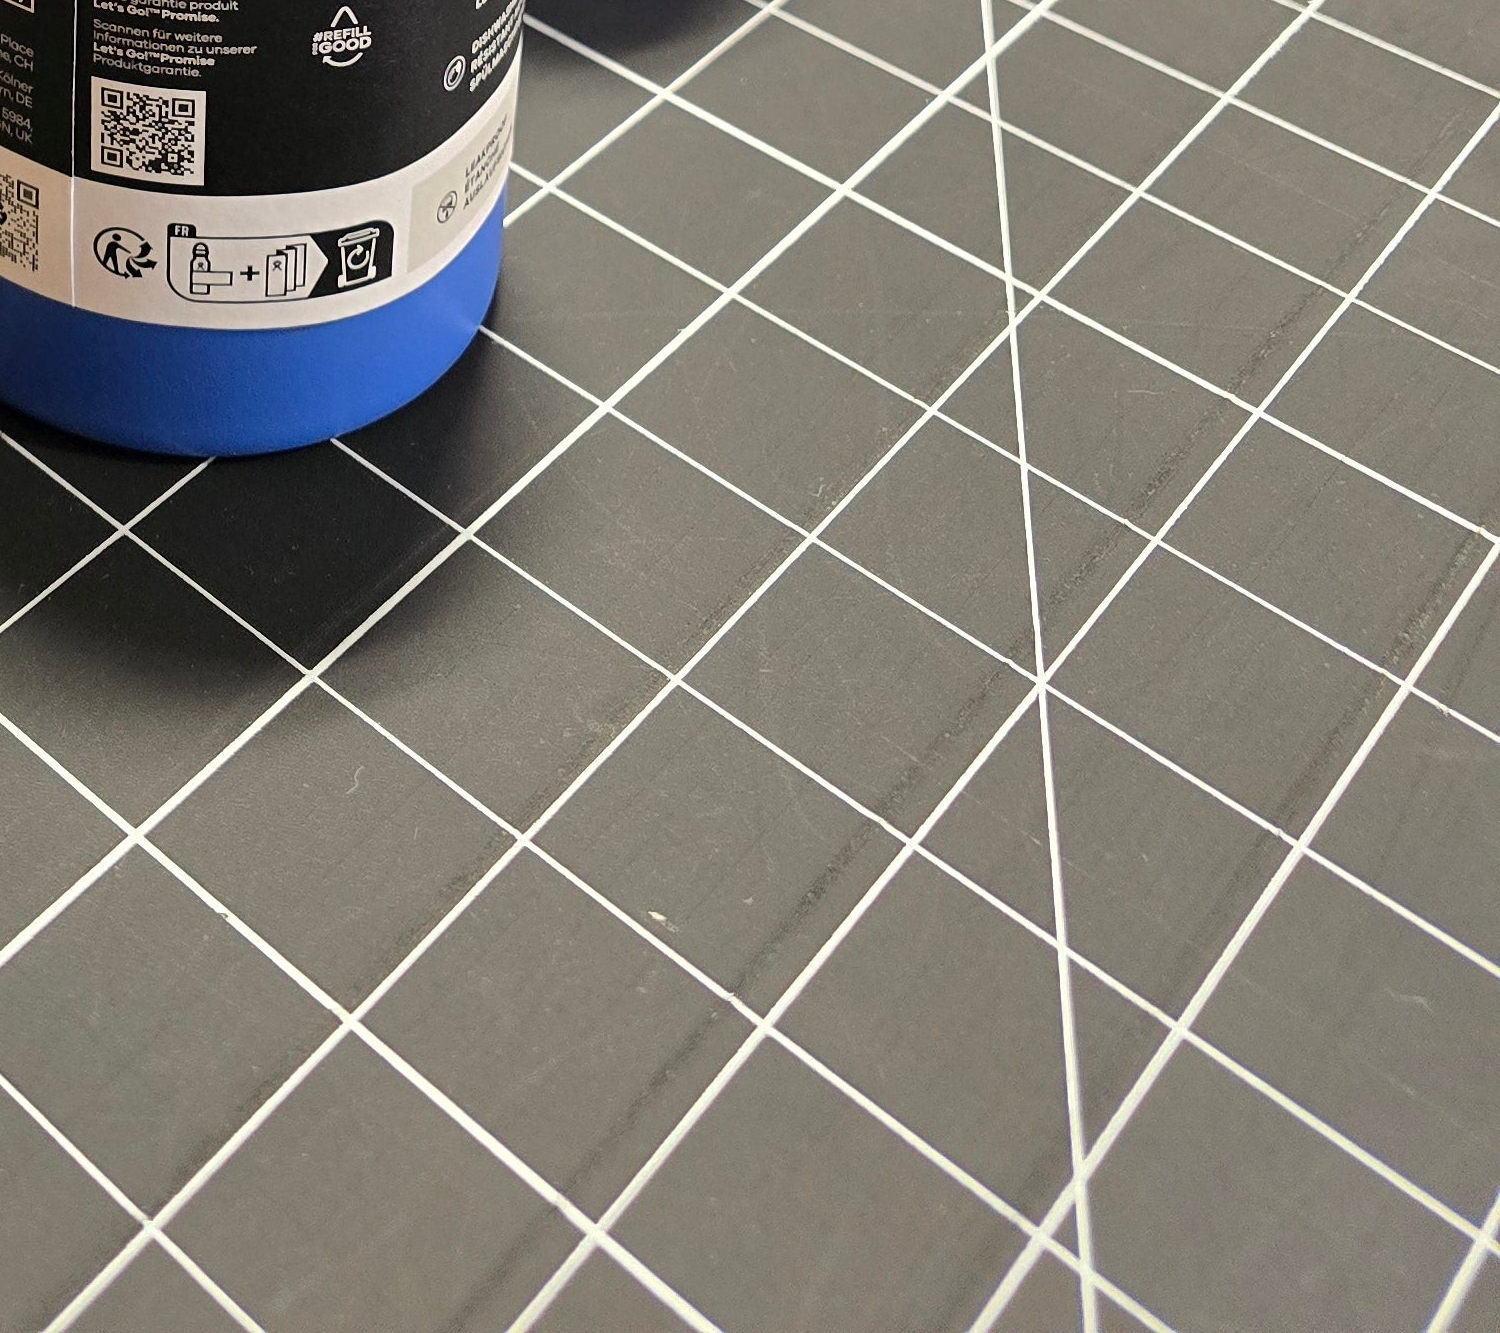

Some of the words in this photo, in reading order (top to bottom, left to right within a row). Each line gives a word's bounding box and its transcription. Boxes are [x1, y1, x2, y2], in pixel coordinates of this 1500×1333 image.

[161, 8, 220, 23] Promise.
[189, 0, 239, 12] produit
[92, 18, 150, 38] Scannen
[151, 27, 172, 41] für
[173, 32, 223, 44] weitere
[0, 33, 35, 59] Place
[92, 29, 185, 54] Informationen
[186, 44, 203, 55] zu
[204, 44, 258, 56] unserer
[318, 36, 372, 55] GOOD
[13, 52, 34, 72] CH
[92, 41, 124, 58] Let's
[160, 51, 216, 66] Promise
[92, 53, 202, 78] Produktgarantie.
[15, 90, 33, 109] DE
[1, 105, 34, 132] 5984,
[15, 126, 33, 145] UK
[174, 224, 190, 237] FR
